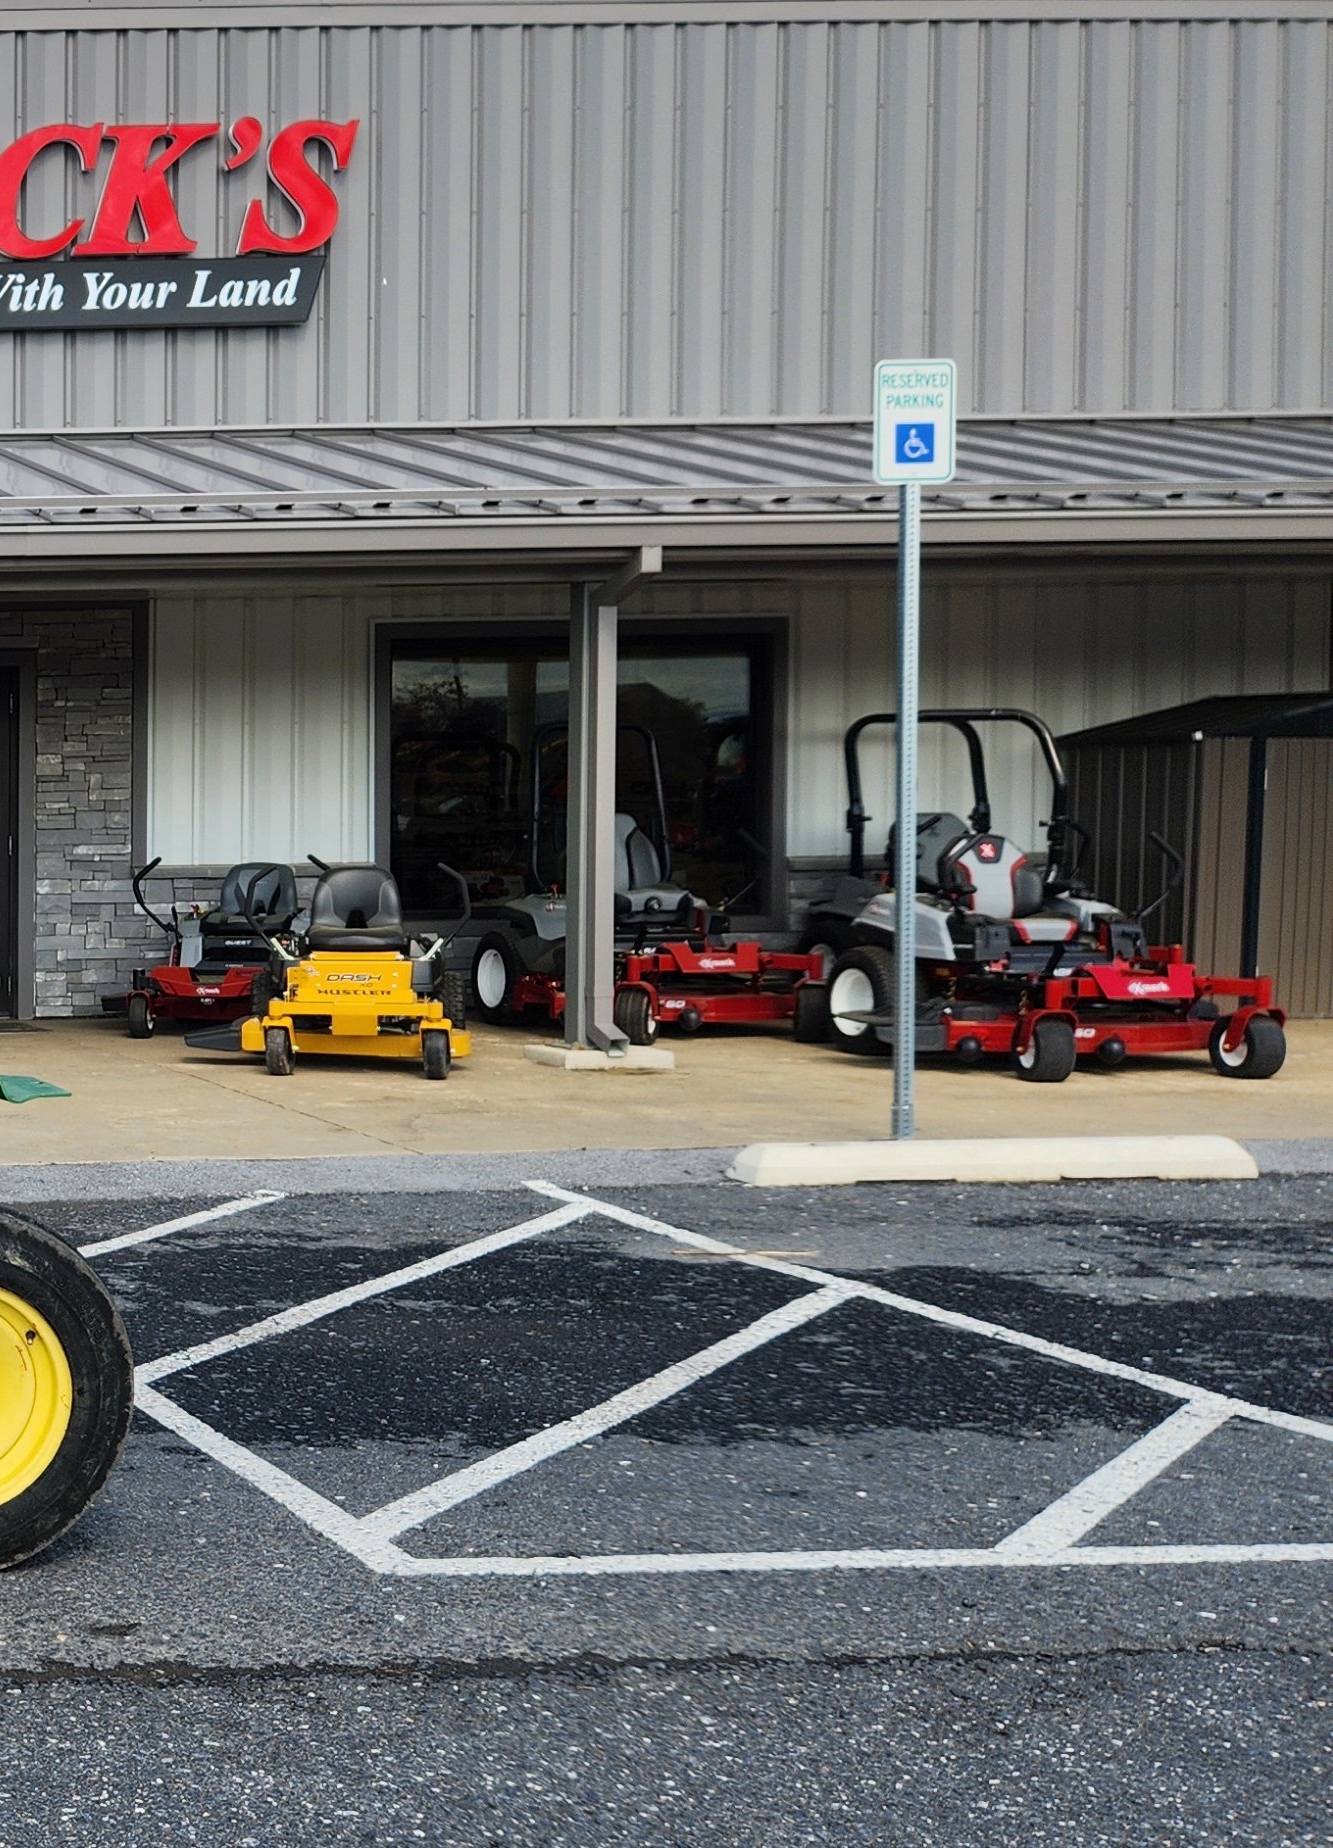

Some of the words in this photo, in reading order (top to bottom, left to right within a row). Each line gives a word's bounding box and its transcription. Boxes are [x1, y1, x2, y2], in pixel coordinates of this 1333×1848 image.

[80, 270, 178, 310] Your
[185, 267, 302, 308] Land
[881, 373, 949, 389] RESERVED
[886, 394, 944, 408] PARKING
[326, 973, 382, 984] DASH
